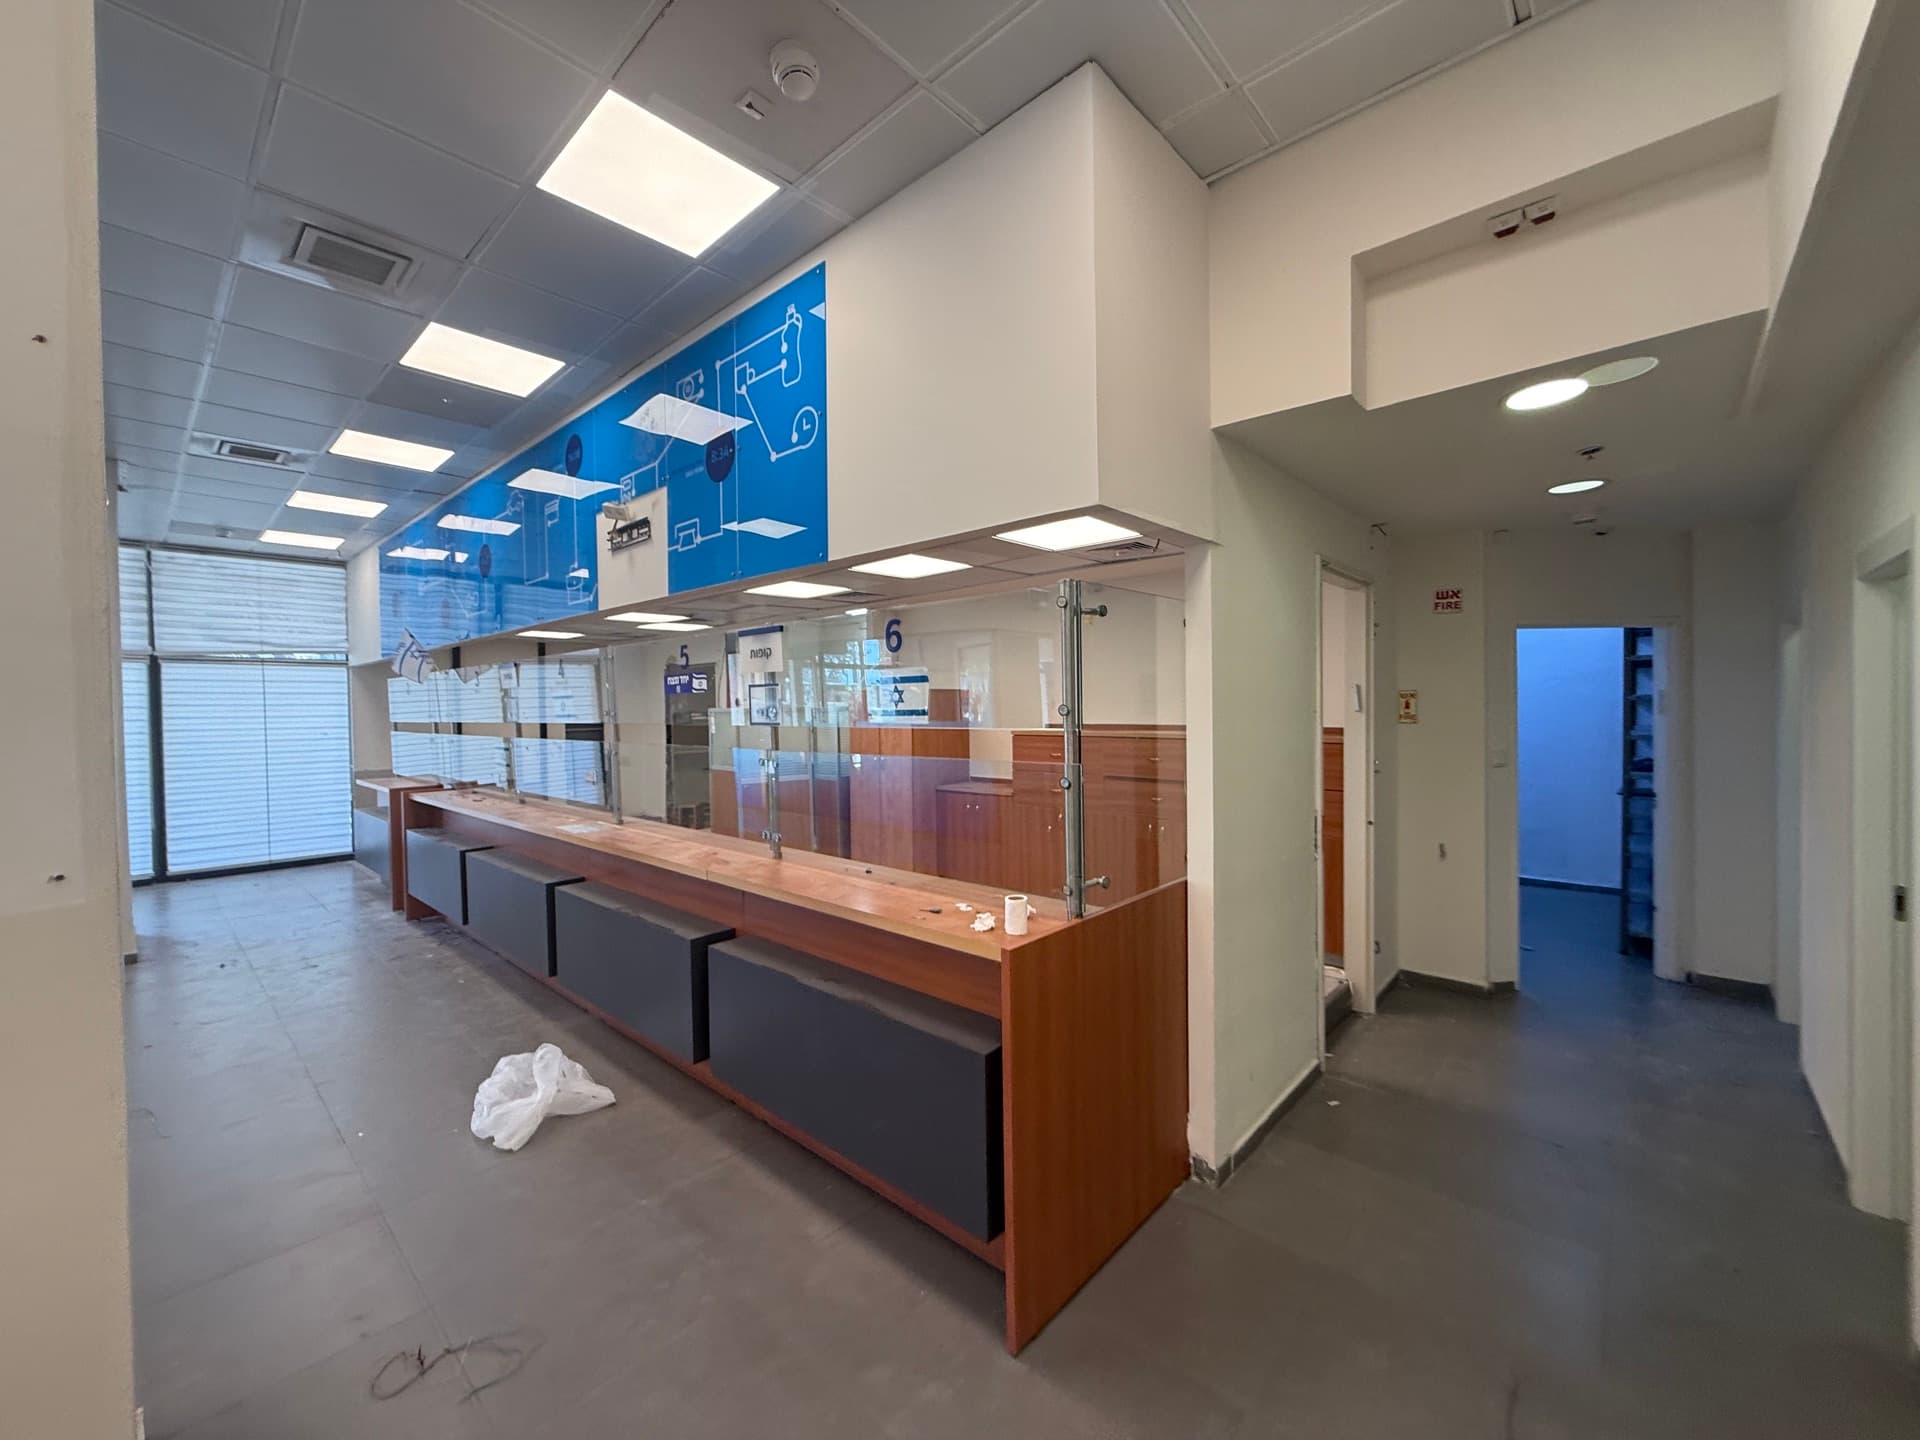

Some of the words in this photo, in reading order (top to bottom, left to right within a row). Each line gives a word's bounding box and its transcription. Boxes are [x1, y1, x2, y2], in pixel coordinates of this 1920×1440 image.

[1436, 590, 1460, 600] אש
[1434, 601, 1462, 611] FIRE
[885, 618, 902, 652] 6
[680, 644, 689, 669] 5
[750, 648, 772, 659] קופות
